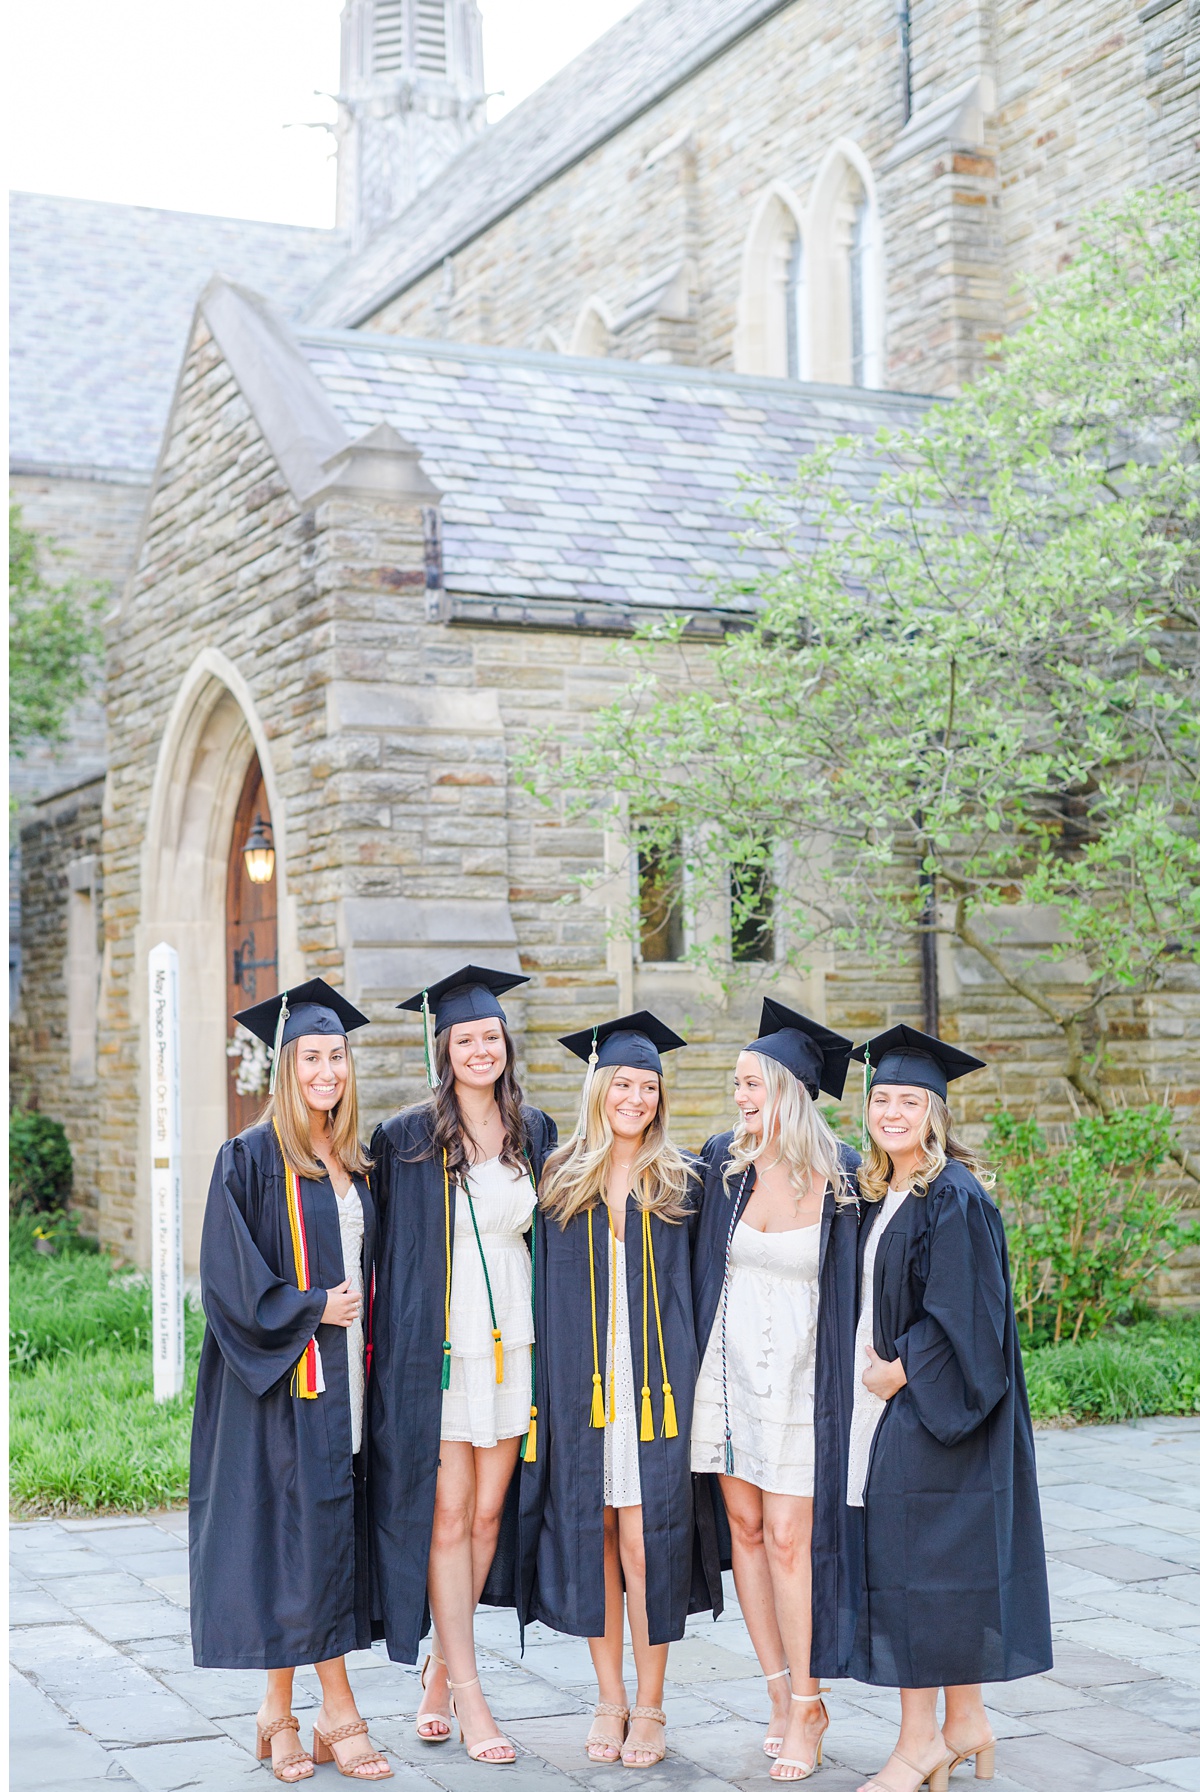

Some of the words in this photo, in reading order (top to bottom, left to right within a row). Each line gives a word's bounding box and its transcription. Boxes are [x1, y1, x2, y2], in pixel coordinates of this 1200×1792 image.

[153, 970, 166, 995] May
[156, 999, 167, 1038] Peace
[156, 1041, 167, 1081] Prevail
[156, 1085, 167, 1104] On
[157, 1107, 168, 1141] Earth
[160, 1318, 169, 1329] La
